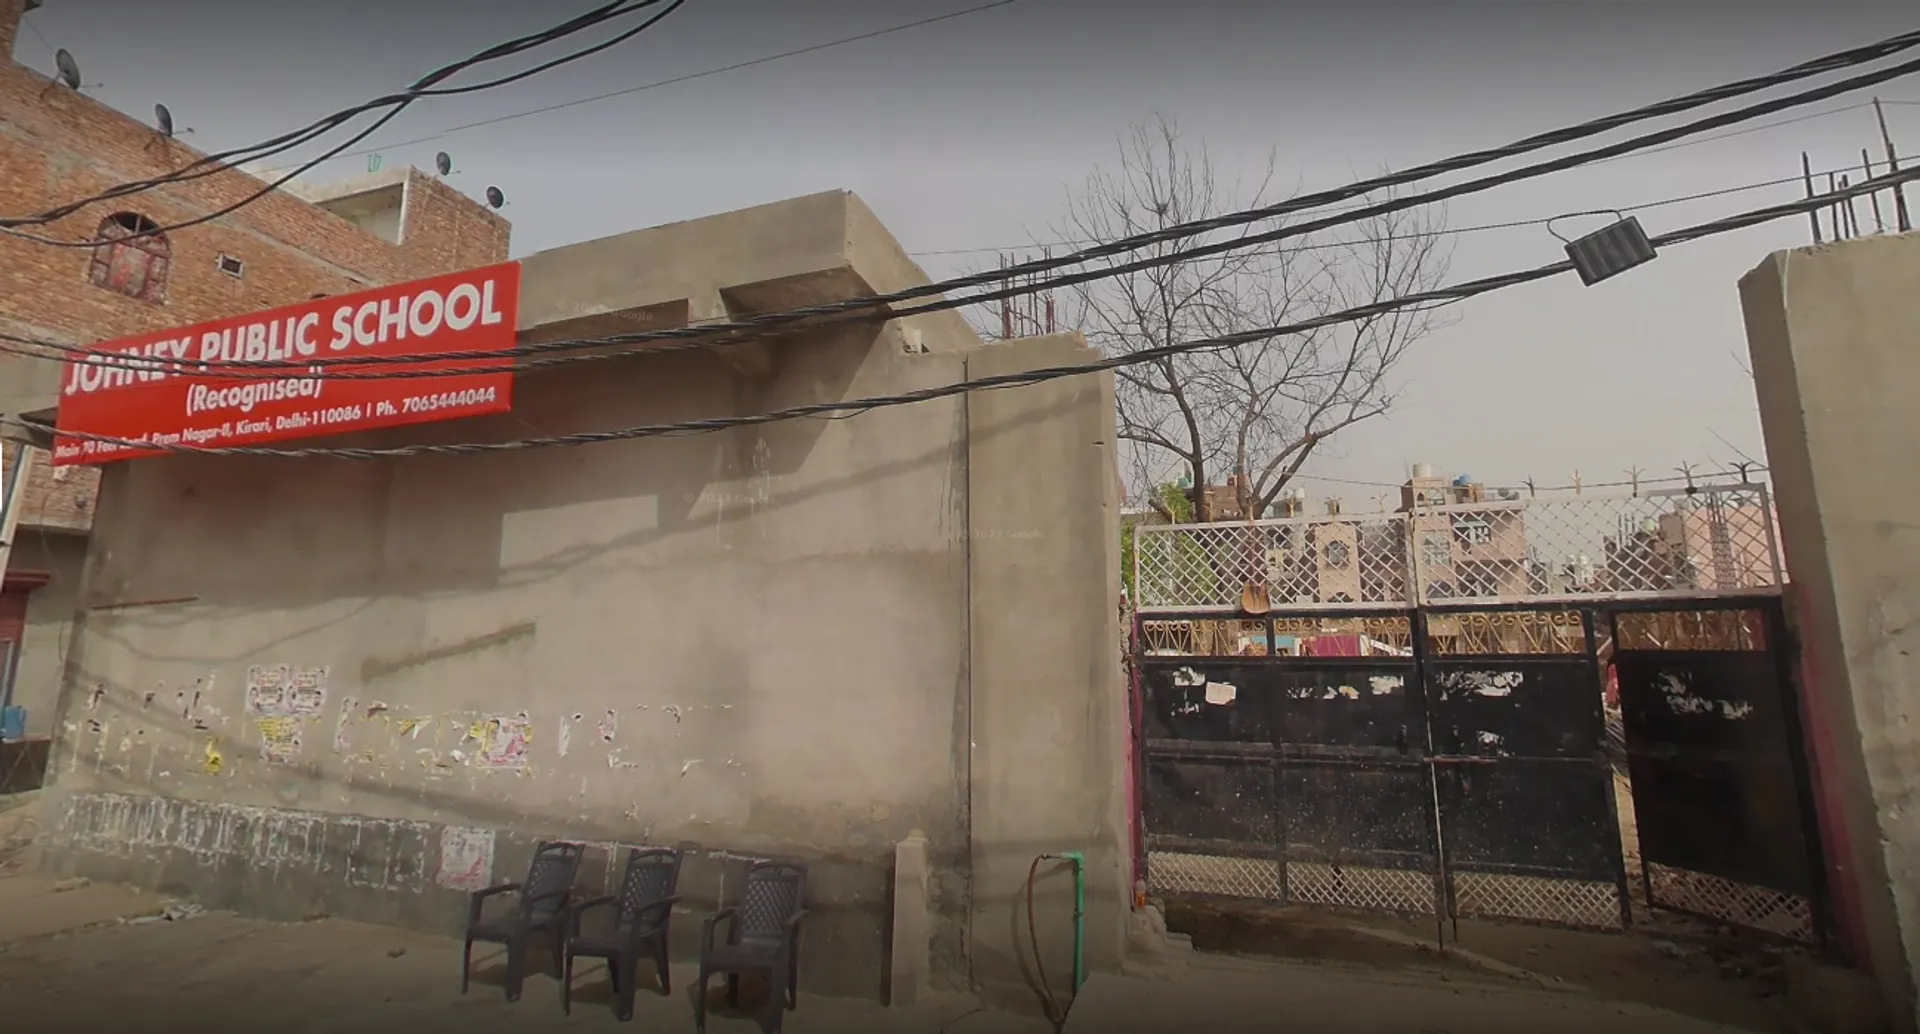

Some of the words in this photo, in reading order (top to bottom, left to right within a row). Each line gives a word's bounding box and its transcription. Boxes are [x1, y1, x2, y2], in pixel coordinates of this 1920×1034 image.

[65, 336, 192, 396] JOHNEY
[199, 312, 319, 371] PUBLIC
[330, 280, 502, 350] SCHOOL
[54, 442, 80, 458] Main
[82, 440, 96, 456] 70
[152, 432, 180, 445] Prem
[182, 422, 233, 443] Nagar-II,
[236, 418, 273, 435] Kirari,
[276, 403, 361, 430] Delhi-110086
[376, 400, 397, 416] Ph.
[402, 386, 496, 413] 7065444044
[187, 366, 323, 416] (Recognised)
